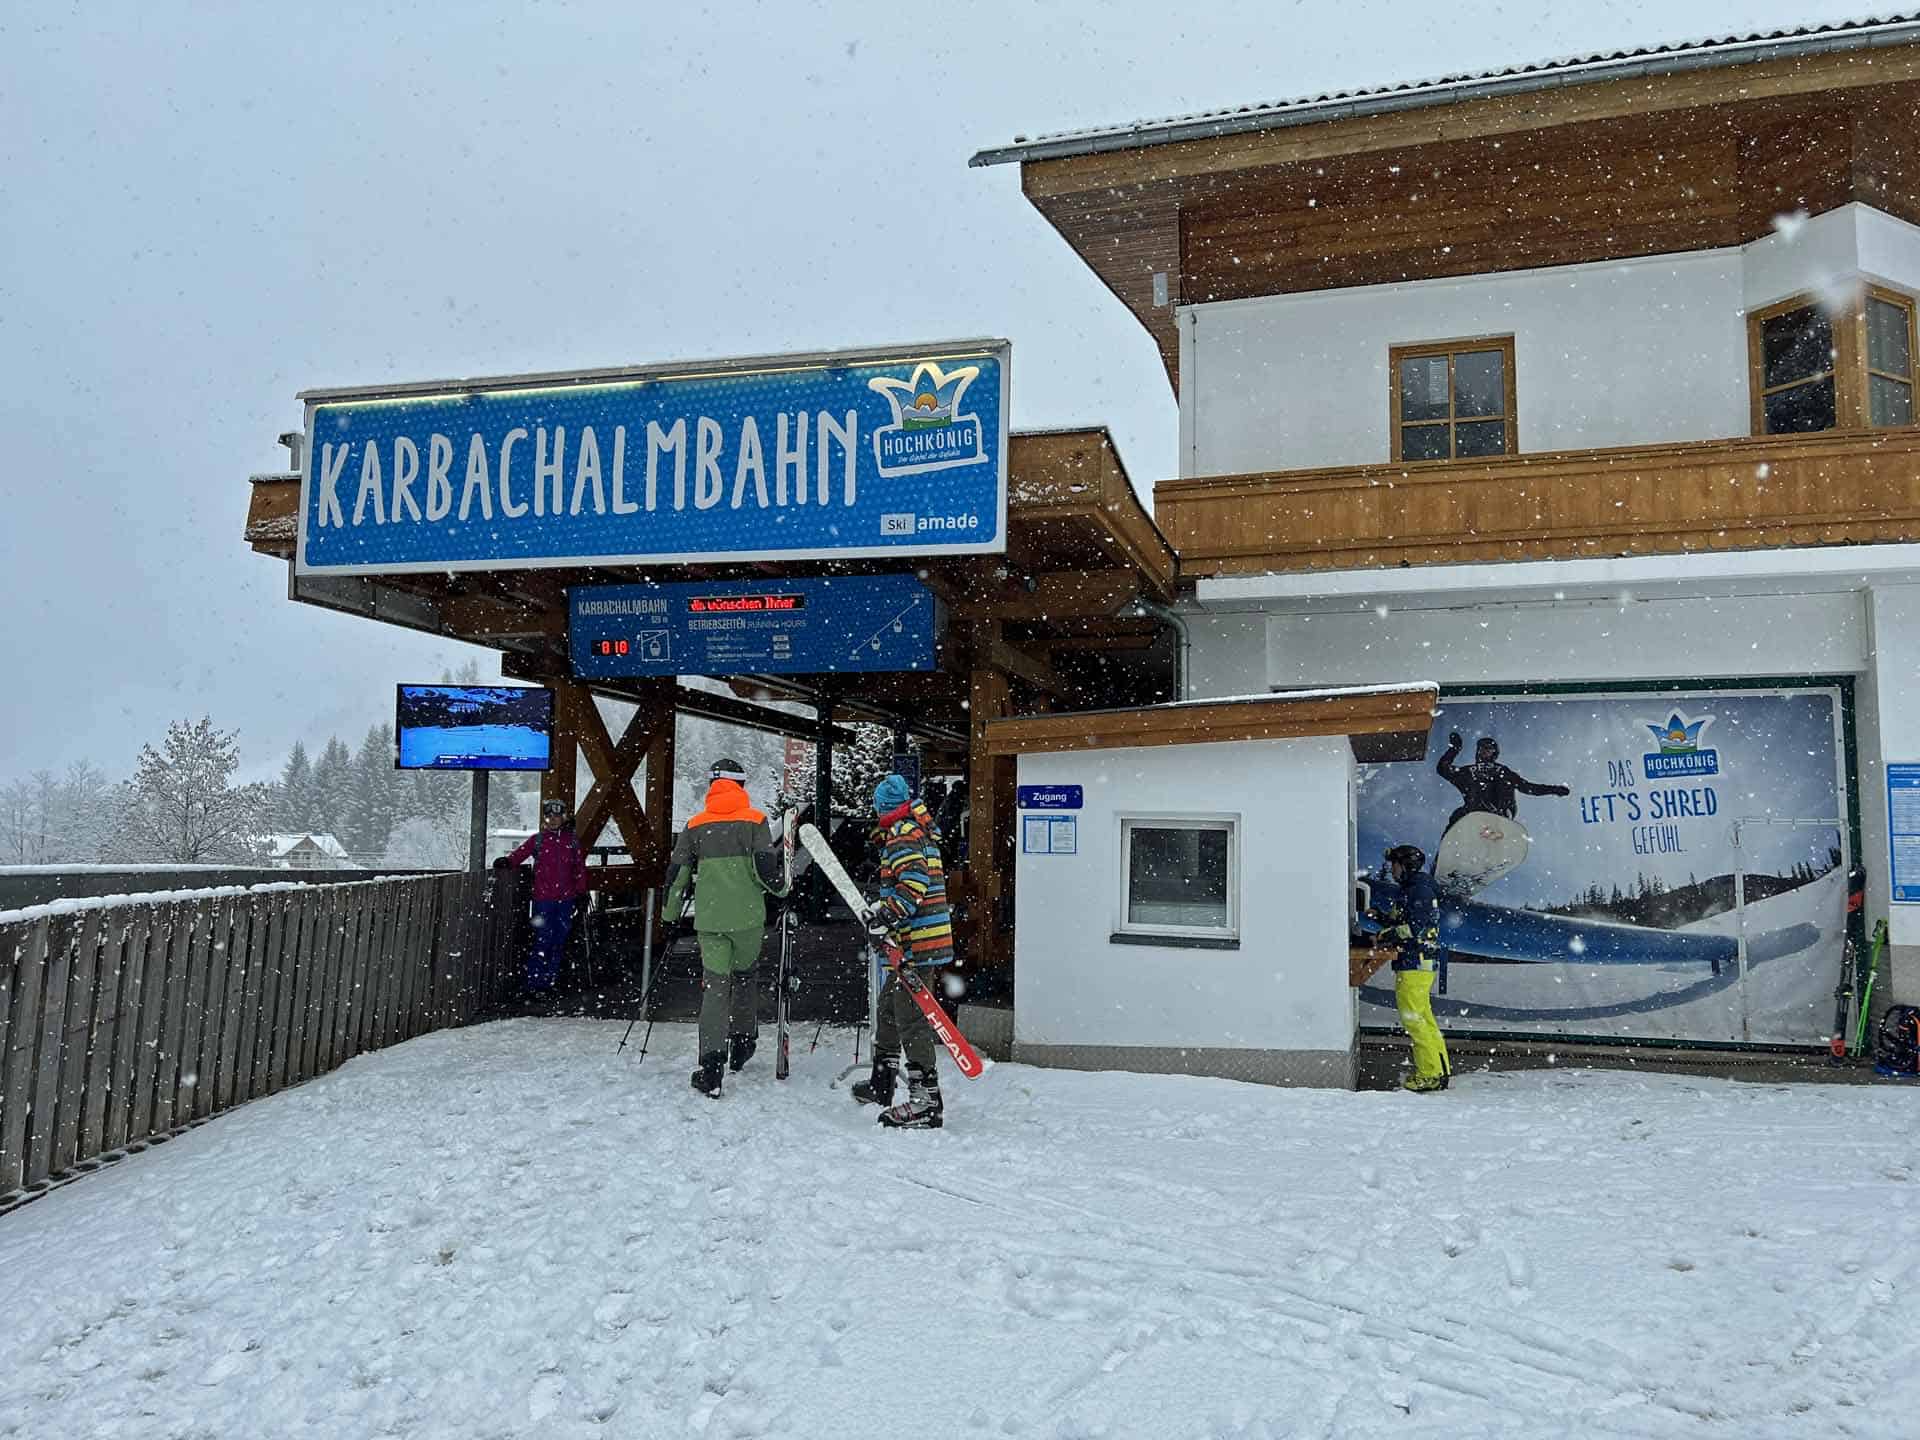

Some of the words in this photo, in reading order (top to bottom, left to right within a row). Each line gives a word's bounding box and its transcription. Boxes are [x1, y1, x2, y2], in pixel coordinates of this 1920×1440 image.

[884, 429, 973, 457] HOCHKÖNIG
[317, 410, 857, 528] KARBACHALMBAHN
[887, 519, 906, 531] Ski
[578, 598, 668, 616] KARBACHALMBAHN
[688, 617, 746, 631] BETRIEBSZEITEN
[781, 618, 807, 629] HOURS
[1607, 760, 1635, 788] DAS
[1647, 754, 1714, 772] HOCHKÖNIG
[1032, 792, 1067, 803] Zugang
[1650, 787, 1718, 819] SHRED
[926, 1012, 972, 1072] HEAD
